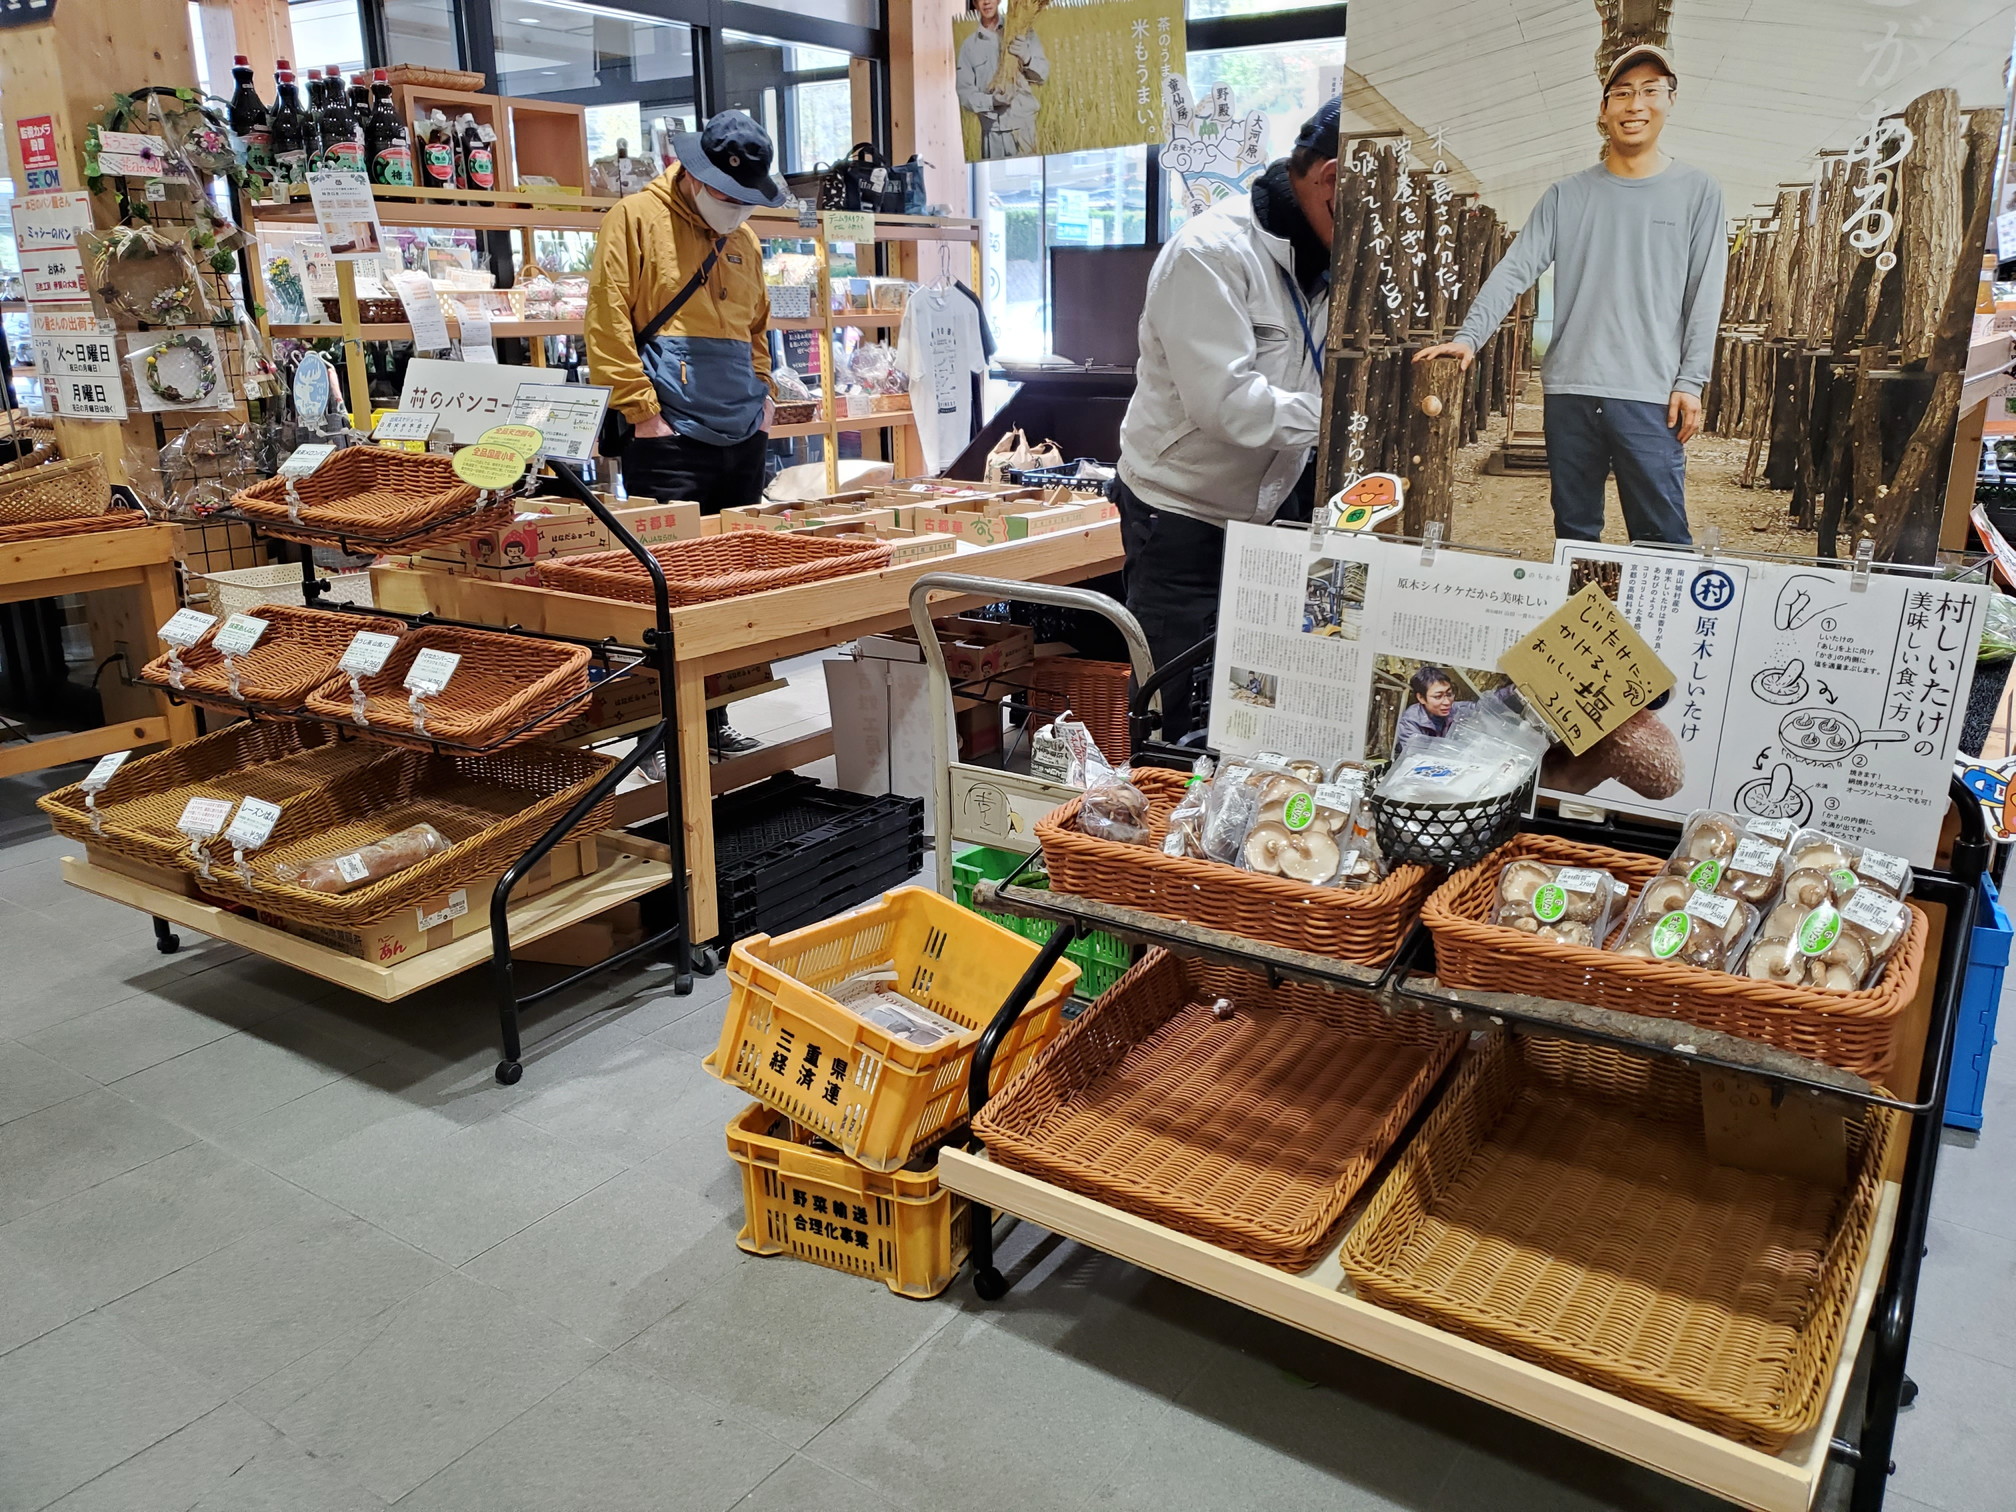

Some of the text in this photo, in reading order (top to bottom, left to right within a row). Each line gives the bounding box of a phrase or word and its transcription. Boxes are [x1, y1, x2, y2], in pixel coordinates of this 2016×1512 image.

[1131, 18, 1157, 133] 米もうまい。
[1167, 79, 1189, 121] 童仙房
[1215, 87, 1230, 117] 野殿
[1172, 143, 1205, 155] お米マップ
[1244, 115, 1264, 159] 大河原
[1842, 0, 1933, 270] がある。
[27, 170, 60, 189] SECOM
[72, 384, 107, 402] 月曜日
[635, 514, 677, 533] 古都華
[924, 517, 964, 534] 古都華
[1397, 577, 1548, 607] 原木シイタケだから美味しい
[1624, 563, 1638, 619] 京都の高級料亭
[1633, 565, 1650, 634] コリコリとした食感
[1647, 566, 1661, 619] あわびのような
[1671, 568, 1686, 614] 南山城村産の
[1696, 578, 1727, 604] 村
[1560, 624, 1613, 684] かけると
[1815, 650, 1867, 664] 「かさ」の内側に
[1816, 641, 1875, 656] 「あし」を上に向け
[1818, 633, 1854, 644] しいたけの
[1888, 591, 1934, 722] 美味しい食べ方
[1531, 638, 1616, 732] おいしい塩
[1680, 616, 1719, 742] 原木しいたけ
[1813, 660, 1901, 676] 塩を適量まぶします。
[1914, 592, 1973, 757] 村しいたけの
[1545, 691, 1582, 739] 316円
[1820, 820, 1876, 836] 水滴が出てきたら
[1822, 811, 1873, 826] 「かさ」の内側に
[1756, 861, 1774, 869] 250円
[379, 942, 408, 961] あん
[775, 1028, 848, 1082] 三重県
[769, 1049, 841, 1106] 経済連
[791, 1189, 869, 1227] 野菜輸送
[793, 1212, 870, 1251] 合理化事業
